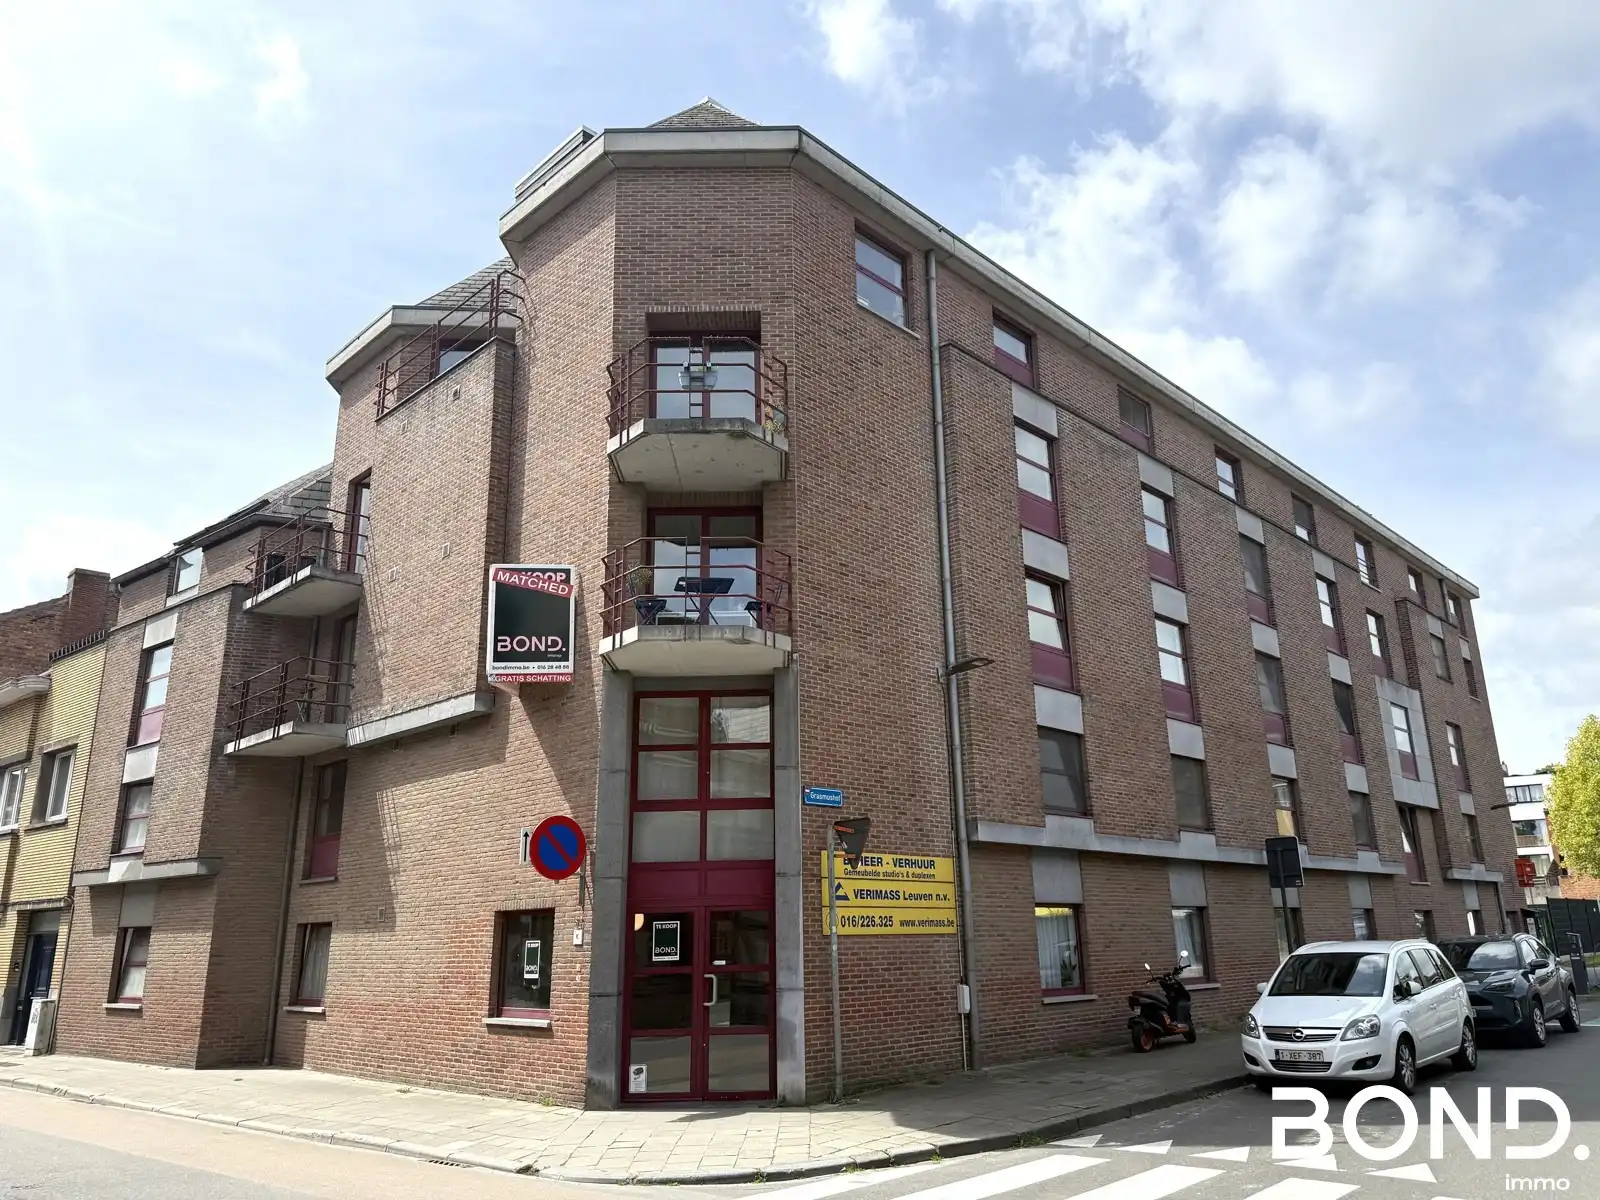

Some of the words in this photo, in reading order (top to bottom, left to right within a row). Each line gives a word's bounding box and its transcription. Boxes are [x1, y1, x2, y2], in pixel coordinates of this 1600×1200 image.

[497, 571, 569, 595] MATCHED
[497, 636, 566, 652] BOND.
[526, 674, 571, 682] SCHATTING
[892, 857, 936, 870] VERHUUR
[843, 868, 881, 877] Gemeubelde
[882, 869, 905, 878] studio's
[906, 870, 910, 878] &
[911, 870, 936, 880] duplexen
[853, 888, 901, 901] VERIMASS
[903, 890, 933, 901] Leuven
[935, 894, 950, 902] n.v.
[840, 915, 894, 928] 016/226.325
[899, 917, 955, 928] www.verimass.be
[1280, 1051, 1322, 1061] 1-XEF-387
